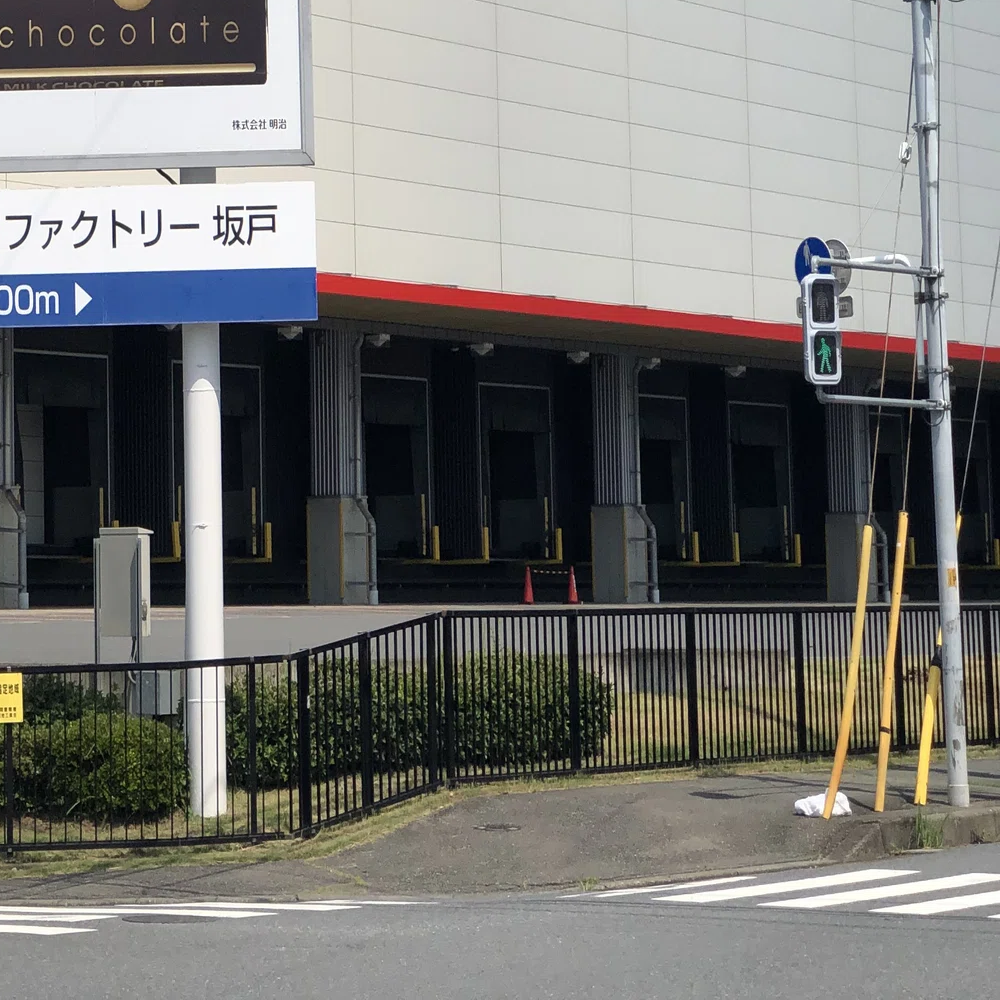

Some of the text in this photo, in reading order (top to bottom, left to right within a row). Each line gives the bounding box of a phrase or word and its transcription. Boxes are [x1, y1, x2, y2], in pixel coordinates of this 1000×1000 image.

[232, 118, 287, 130] 株式会社 明治
[212, 205, 277, 247] 坂戸
